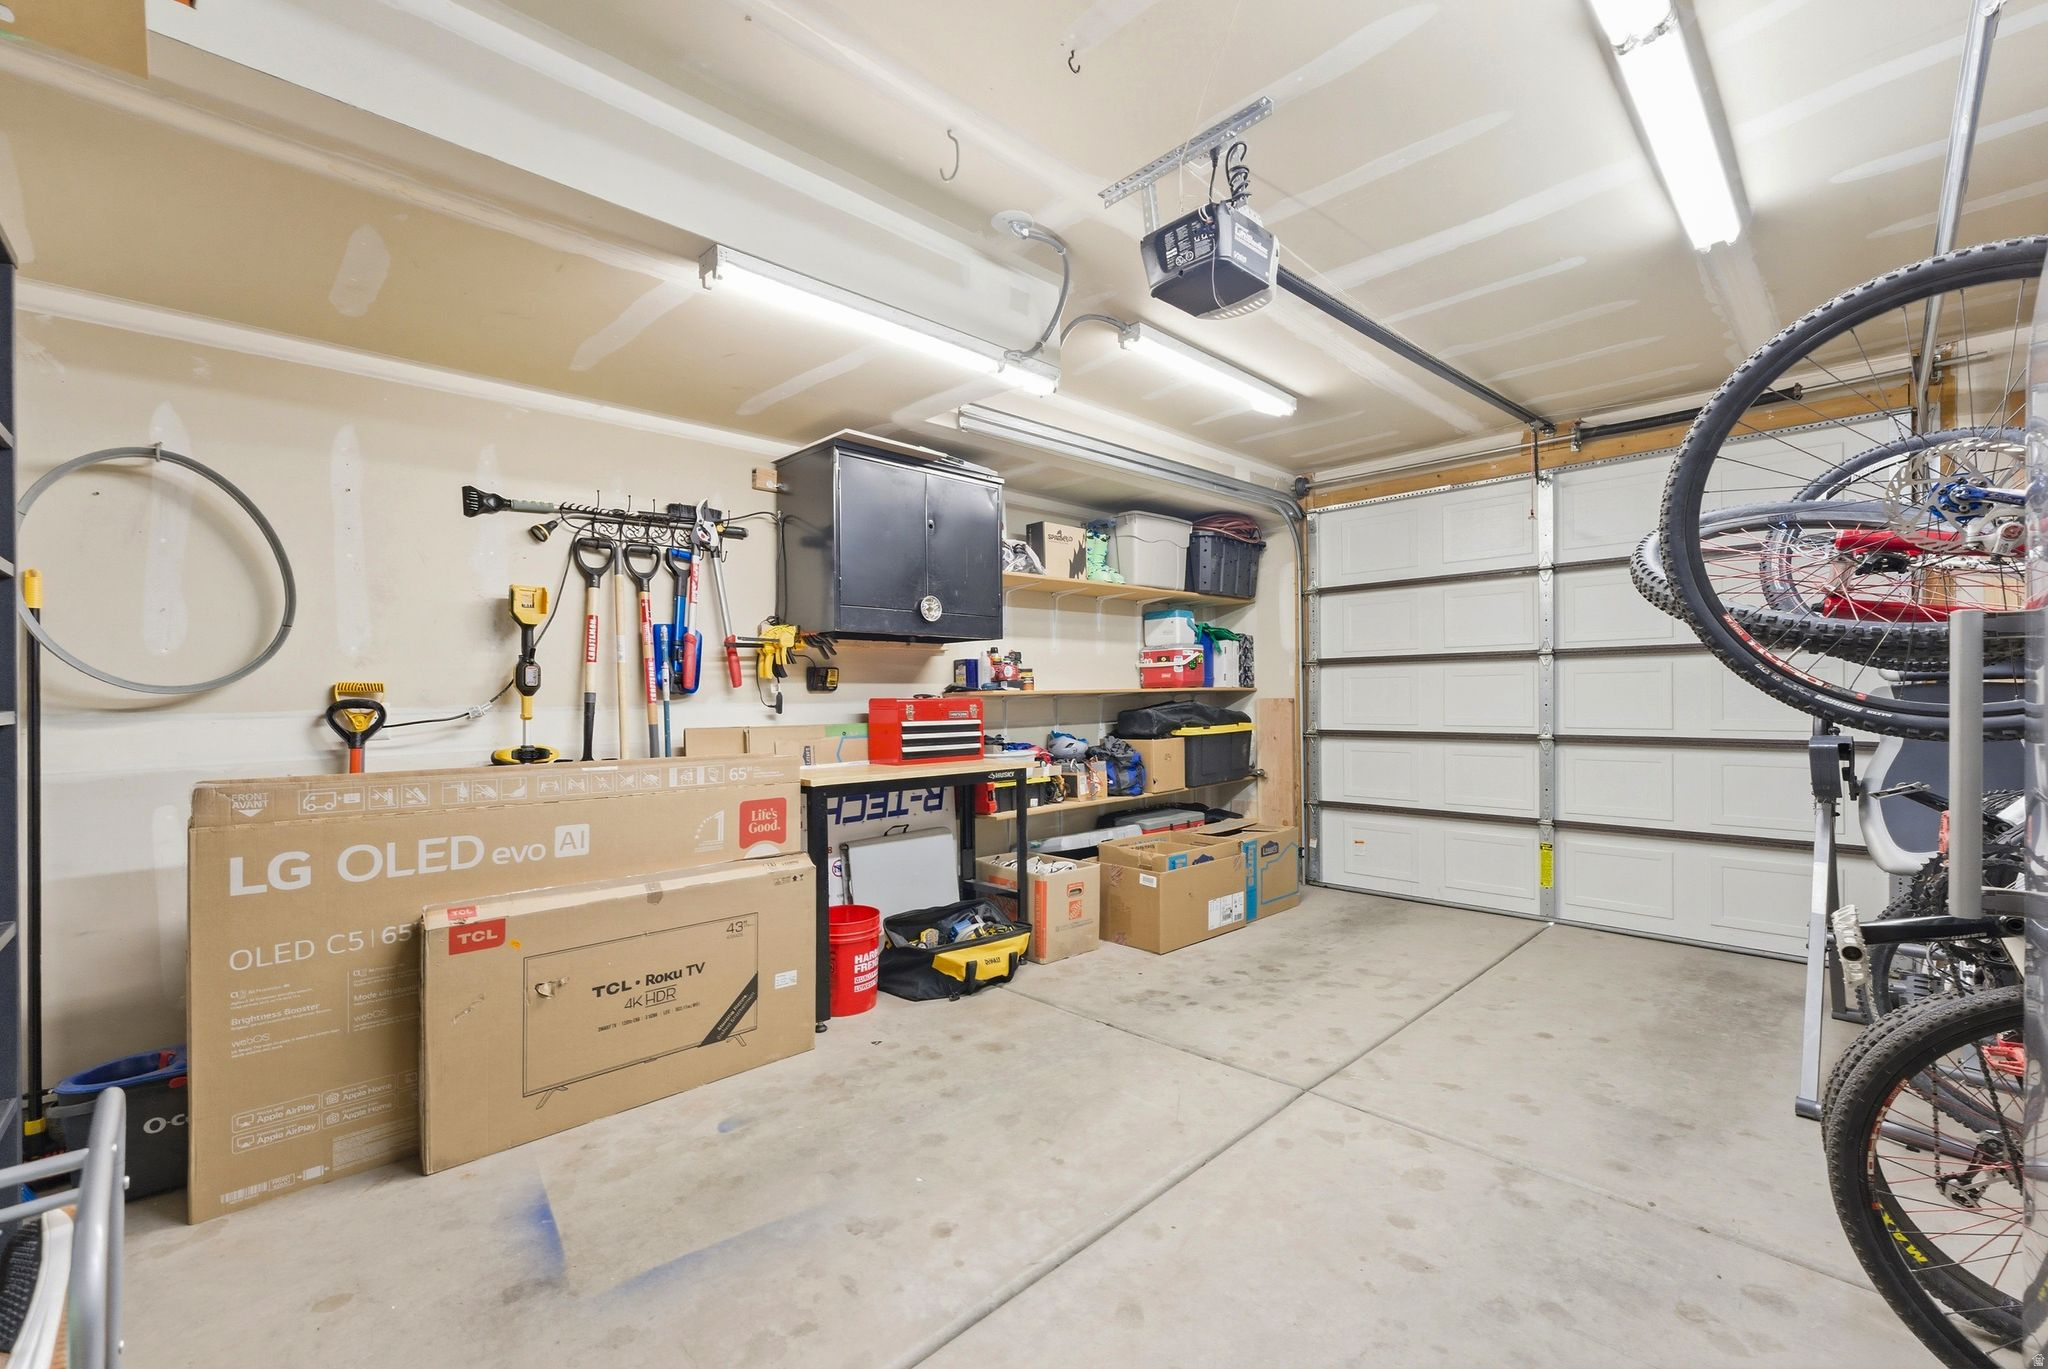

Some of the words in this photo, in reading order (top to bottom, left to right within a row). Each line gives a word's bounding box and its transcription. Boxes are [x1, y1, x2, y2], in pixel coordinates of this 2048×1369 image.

[231, 792, 269, 803] FRONT
[231, 799, 270, 809] AVANT
[751, 808, 778, 822] Life's
[748, 820, 781, 835] Good.
[229, 851, 312, 896] LG
[337, 835, 485, 883] OLED
[492, 843, 546, 864] evo
[559, 831, 586, 852] AI
[451, 908, 473, 917] TCL
[457, 928, 499, 945] TCL
[229, 939, 315, 971] OLED
[327, 930, 364, 955] C5
[592, 980, 632, 997] TCL
[645, 969, 683, 986] Roku
[686, 962, 706, 976] TV
[624, 995, 643, 1009] 4K
[645, 987, 677, 1005] HDR
[231, 1011, 282, 1026] Brightness
[284, 1003, 321, 1015] Booster
[257, 1111, 284, 1123] Apple
[286, 1103, 316, 1116] AirPlay
[257, 1131, 284, 1144] Apple
[286, 1123, 316, 1136] AirPlay
